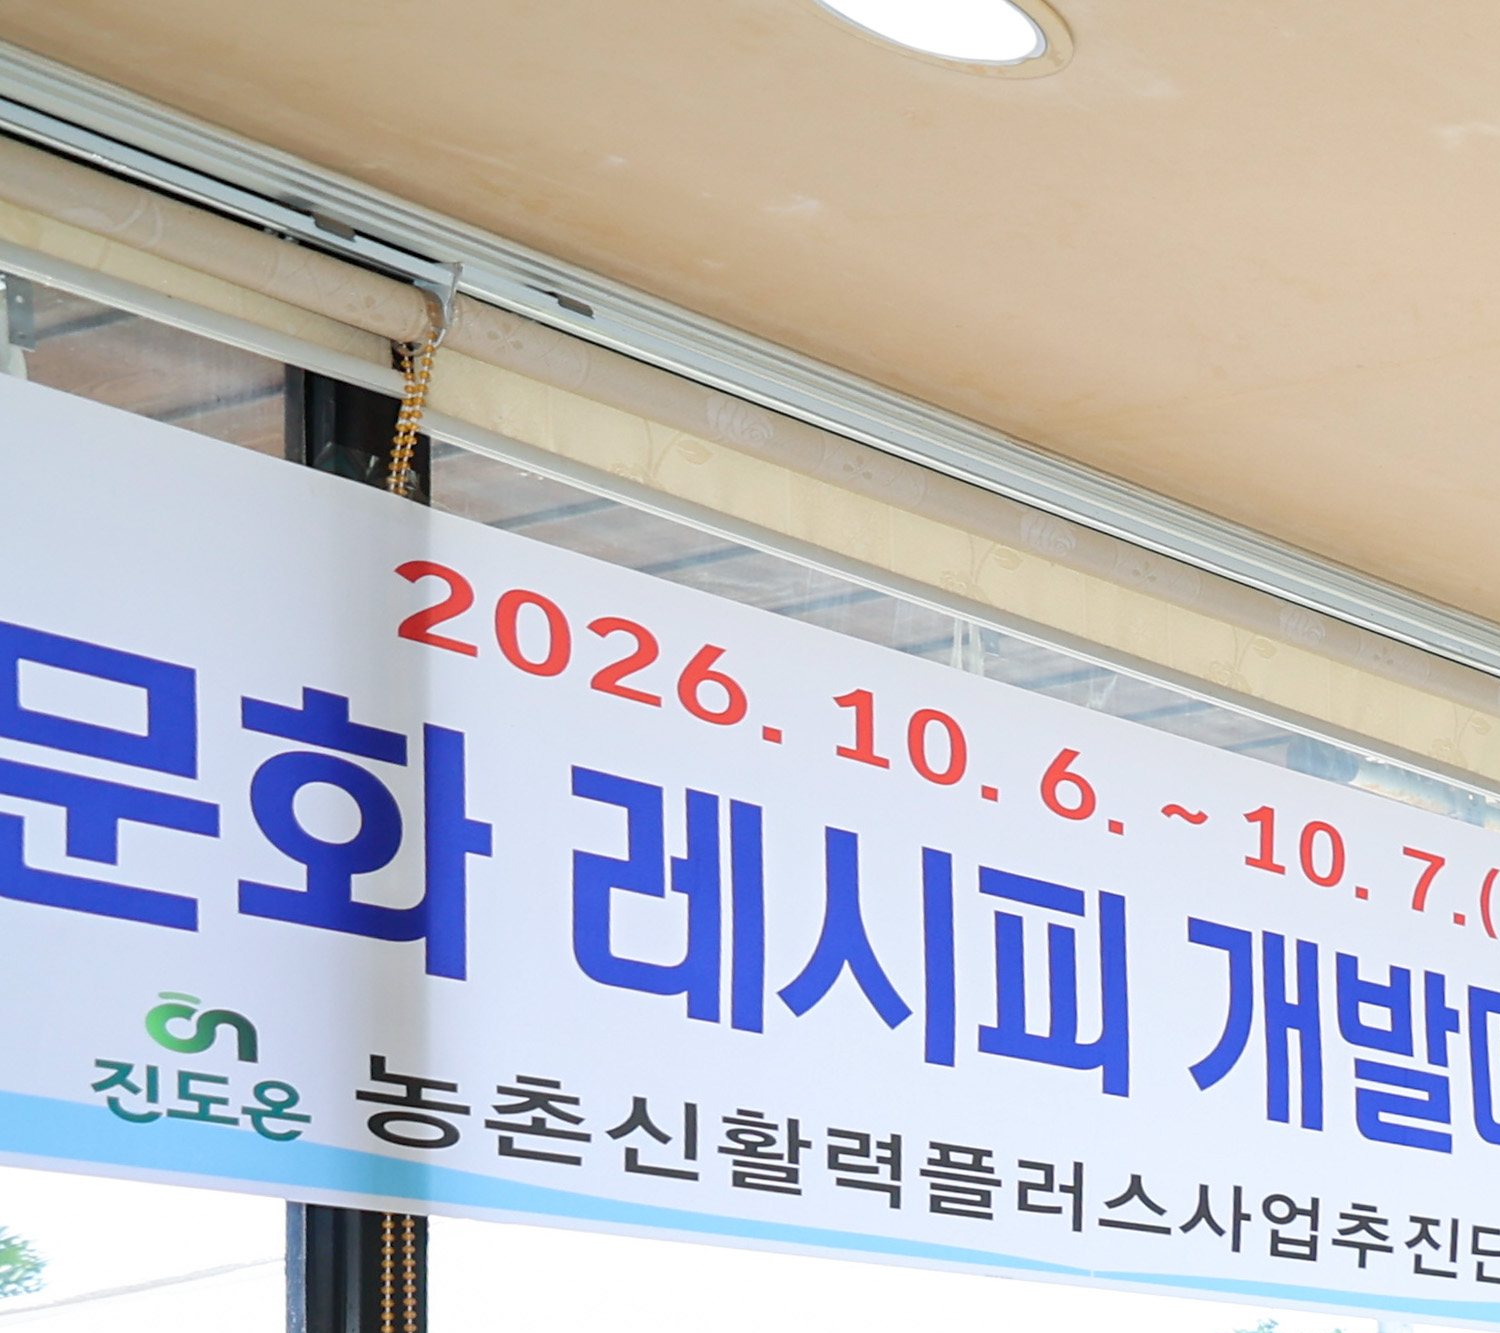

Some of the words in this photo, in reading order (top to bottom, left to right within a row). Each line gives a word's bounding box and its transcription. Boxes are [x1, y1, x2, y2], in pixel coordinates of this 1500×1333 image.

[395, 559, 783, 744] 2026.
[834, 688, 999, 802] 10.
[0, 620, 494, 982] 문화
[571, 765, 1131, 1099] 레시피
[90, 1057, 312, 1142] 진도온
